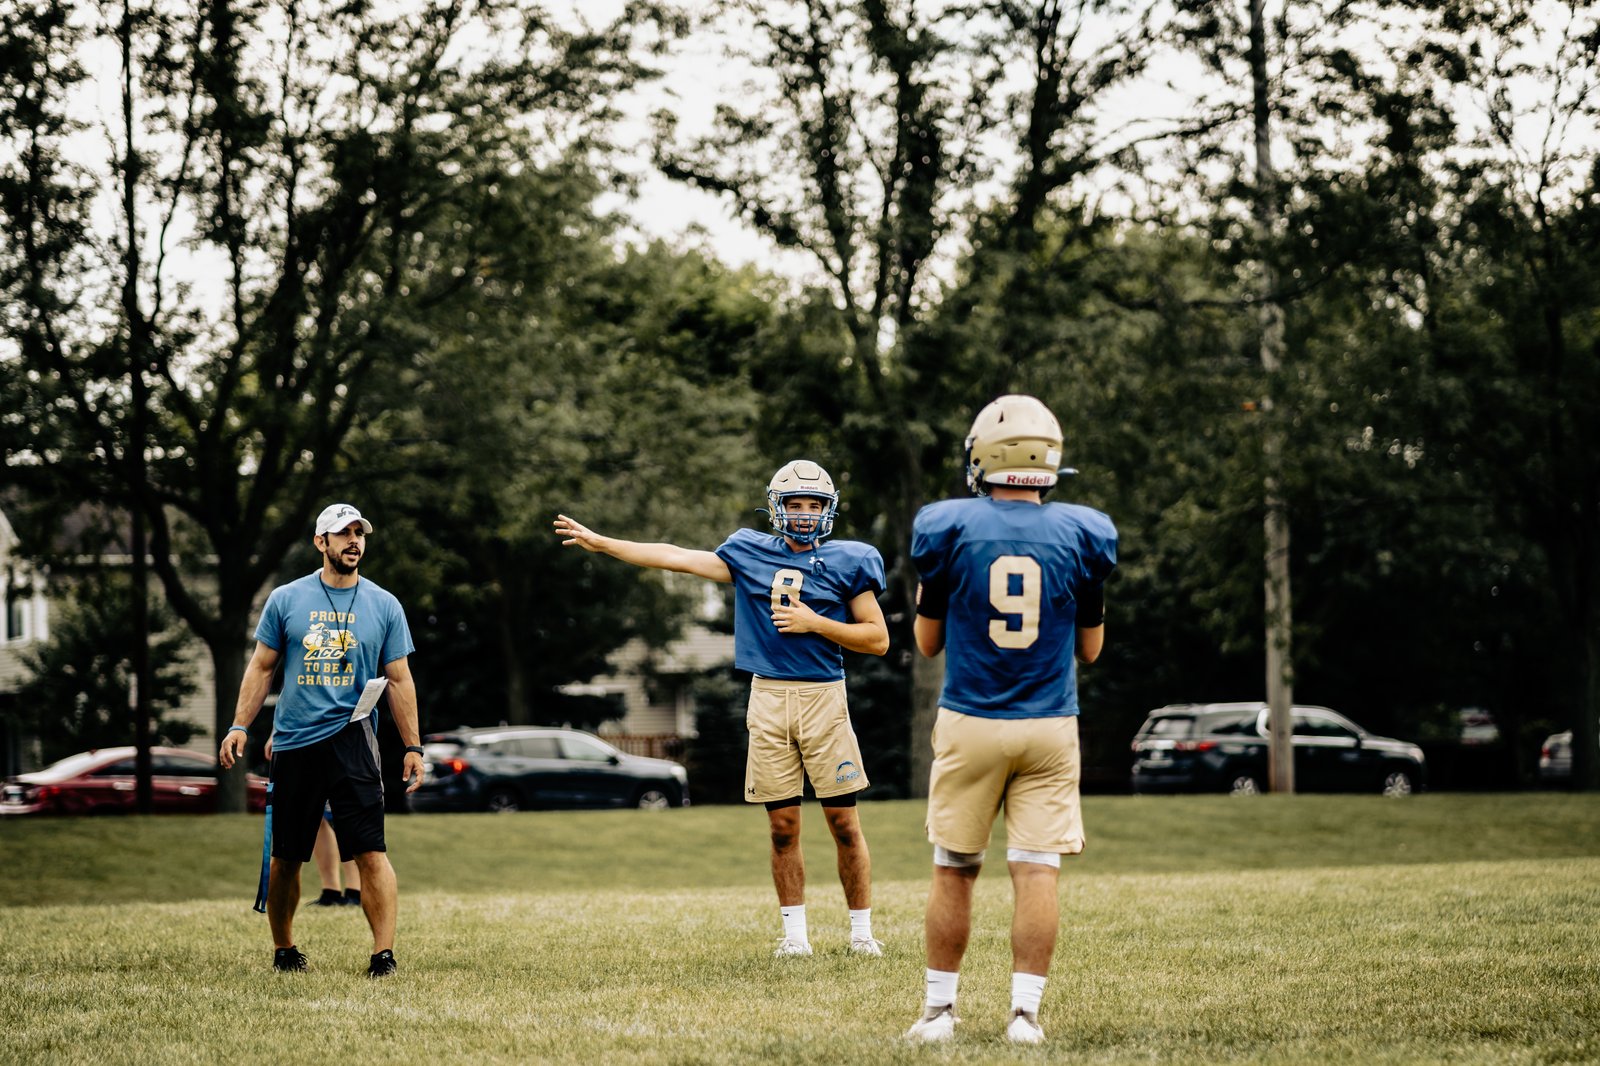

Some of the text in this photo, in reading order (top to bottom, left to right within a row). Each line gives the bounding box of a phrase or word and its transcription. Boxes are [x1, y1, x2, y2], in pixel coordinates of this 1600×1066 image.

[1006, 475, 1050, 485] Riddell
[770, 568, 804, 612] 8
[988, 555, 1041, 649] 9
[309, 611, 356, 624] PROUD
[307, 649, 344, 658] ACC
[304, 662, 354, 673] TO BE A
